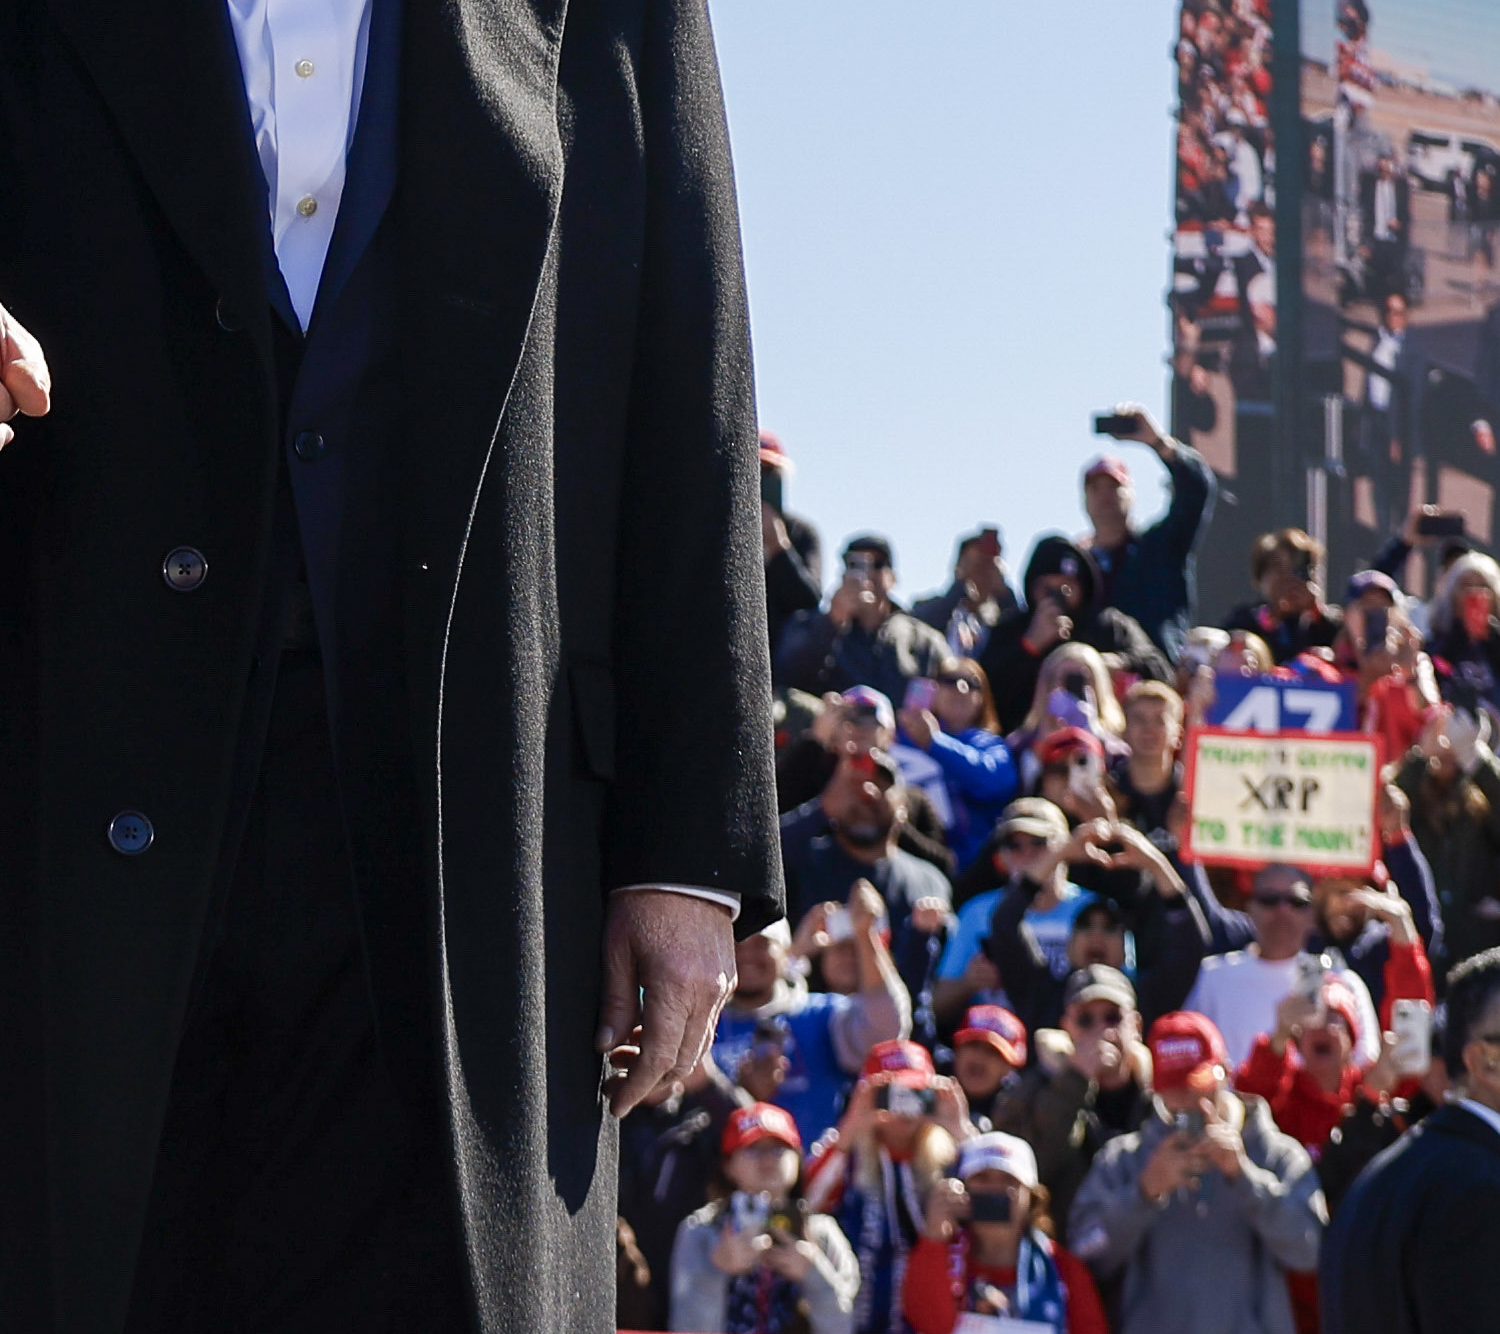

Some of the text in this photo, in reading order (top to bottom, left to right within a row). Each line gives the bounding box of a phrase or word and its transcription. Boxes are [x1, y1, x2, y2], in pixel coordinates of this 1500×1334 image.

[1238, 774, 1319, 812] XRP
[1200, 819, 1226, 841] TO
[1242, 823, 1283, 845] THE
